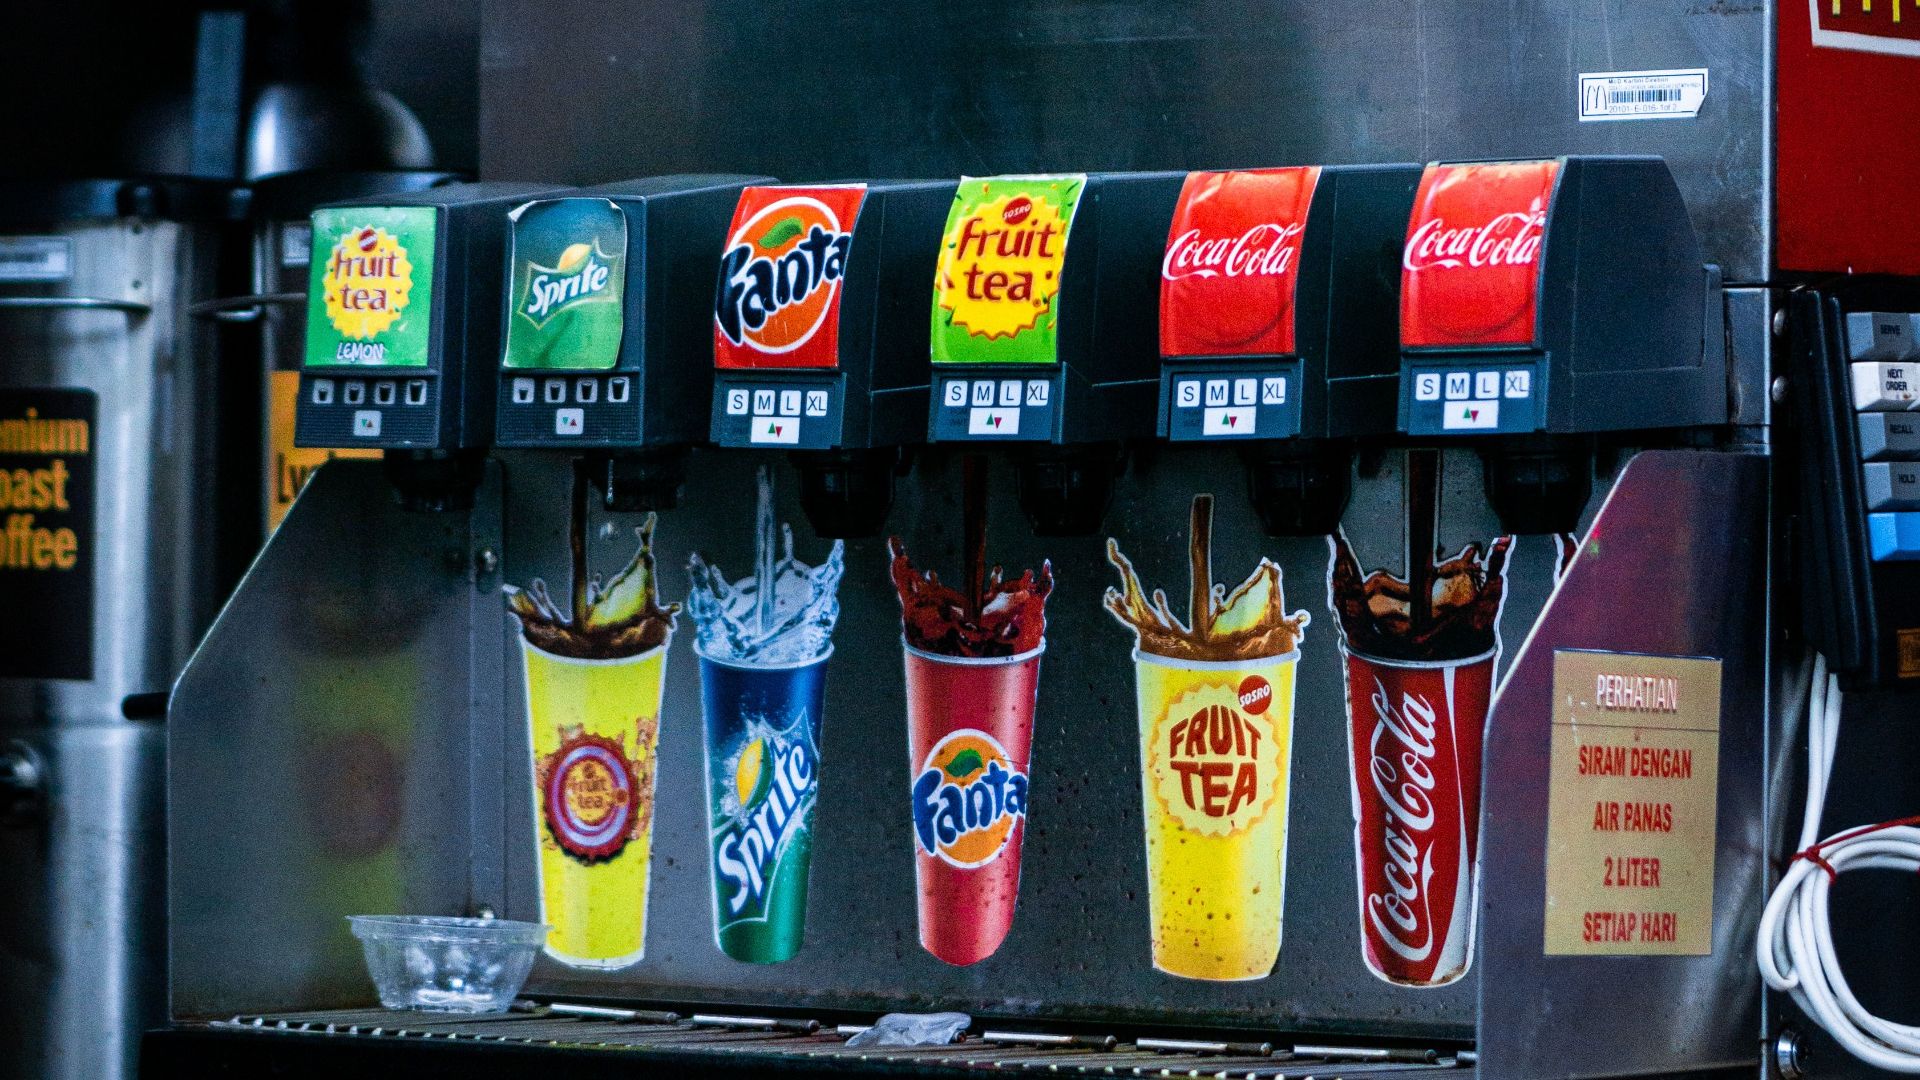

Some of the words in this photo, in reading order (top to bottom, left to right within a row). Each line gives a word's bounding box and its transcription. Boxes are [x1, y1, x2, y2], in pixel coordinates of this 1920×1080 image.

[1003, 203, 1031, 220] SOSRO
[957, 217, 1057, 260] fruit
[1162, 222, 1305, 281] Coca-Cola
[334, 247, 401, 280] fruit
[339, 283, 387, 311] tea
[527, 256, 609, 316] Sprite
[715, 225, 851, 345] Fanta
[963, 262, 1033, 301] tea
[336, 341, 387, 362] LEMON
[1422, 378, 1434, 395] S
[1450, 378, 1465, 394] M
[1482, 377, 1491, 393] L
[1506, 376, 1528, 392] XL
[1885, 380, 1908, 391] ORDER
[1887, 368, 1903, 379] NEXT
[733, 394, 743, 410] S
[758, 394, 771, 410] M
[786, 395, 794, 411] L
[807, 395, 827, 411] XL
[951, 385, 962, 401] S
[977, 385, 990, 401] M
[1006, 385, 1014, 401] L
[1028, 385, 1048, 401] XL
[1183, 386, 1194, 402] S
[1210, 385, 1224, 401] M
[1241, 384, 1250, 400] L
[1264, 383, 1285, 399] XL
[1889, 423, 1914, 434] RECALL
[1239, 684, 1270, 707] SOSRO
[1596, 673, 1678, 712] PERHATIAN
[1169, 704, 1262, 760] FRUIT
[1578, 744, 1626, 776] SIRAM
[1630, 747, 1692, 779] DENGAN
[1169, 760, 1258, 817] TEA
[912, 761, 1028, 854] Fanta
[1368, 675, 1436, 962] Coca-Cola
[1593, 801, 1620, 831] AIR
[1624, 801, 1673, 833] PANAS
[718, 741, 811, 912] Sprite
[1603, 856, 1613, 887] 2
[1617, 856, 1660, 887] LITER
[1583, 911, 1637, 942] SETIAP
[1641, 911, 1677, 942] HARI
